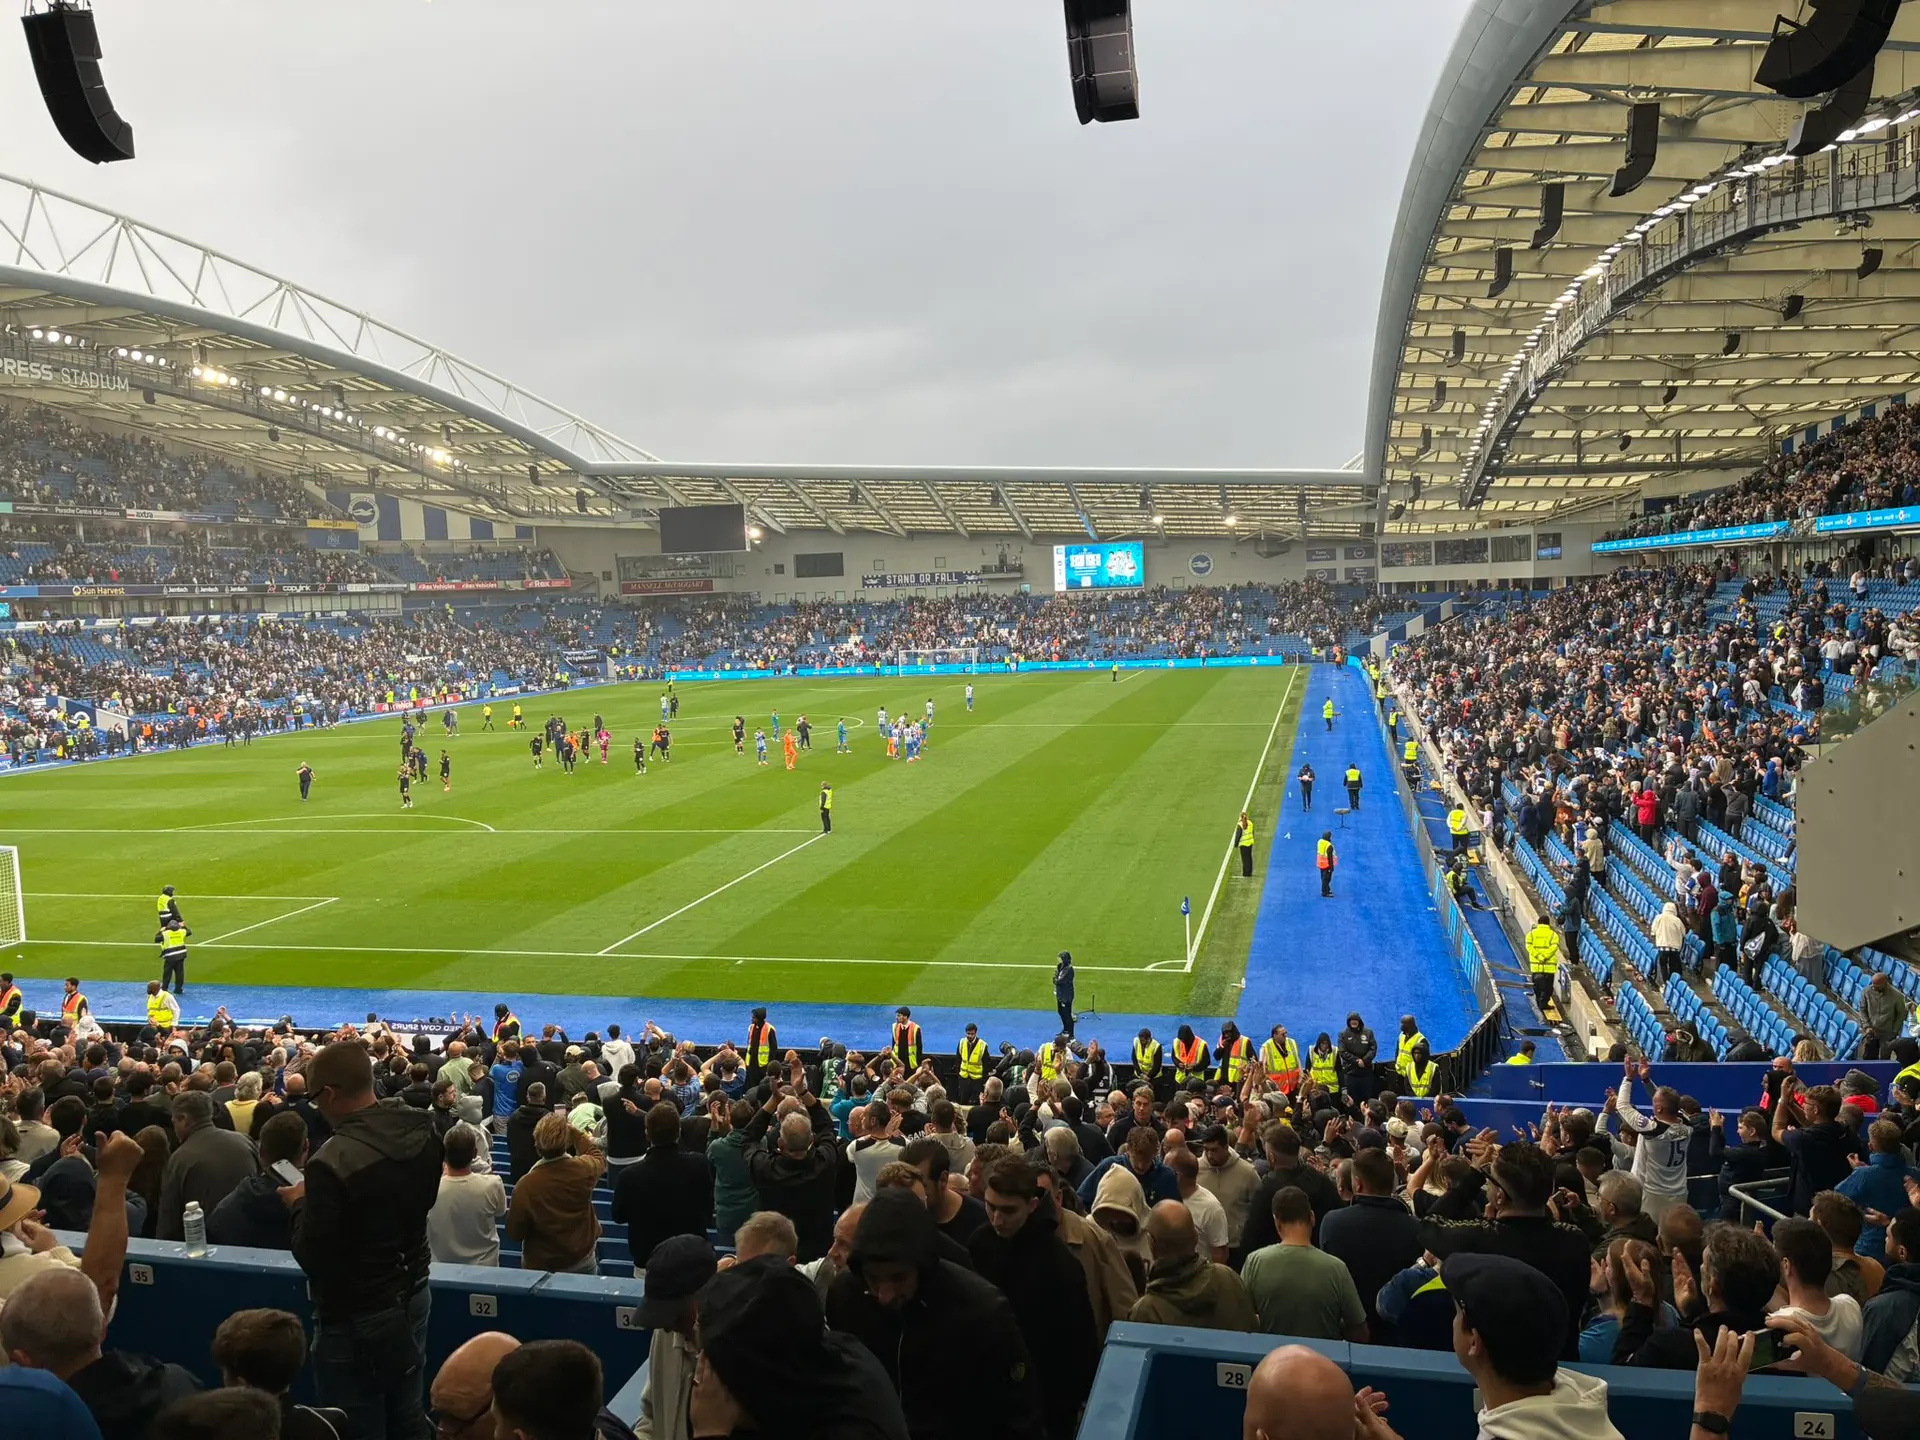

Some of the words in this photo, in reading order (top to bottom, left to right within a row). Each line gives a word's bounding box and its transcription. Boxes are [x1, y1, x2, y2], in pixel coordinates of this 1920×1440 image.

[0, 357, 54, 381] RESS
[61, 367, 129, 393] STADIUM
[534, 580, 550, 588] Rex
[886, 574, 915, 585] STAND
[919, 573, 931, 583] OR
[935, 572, 958, 582] FALL
[82, 587, 96, 596] Sun
[98, 586, 125, 595] Harvest
[1666, 1141, 1685, 1168] 15
[134, 1270, 148, 1282] 35
[475, 1302, 491, 1315] 32
[1225, 1371, 1244, 1387] 28
[1803, 1421, 1825, 1436] 24
